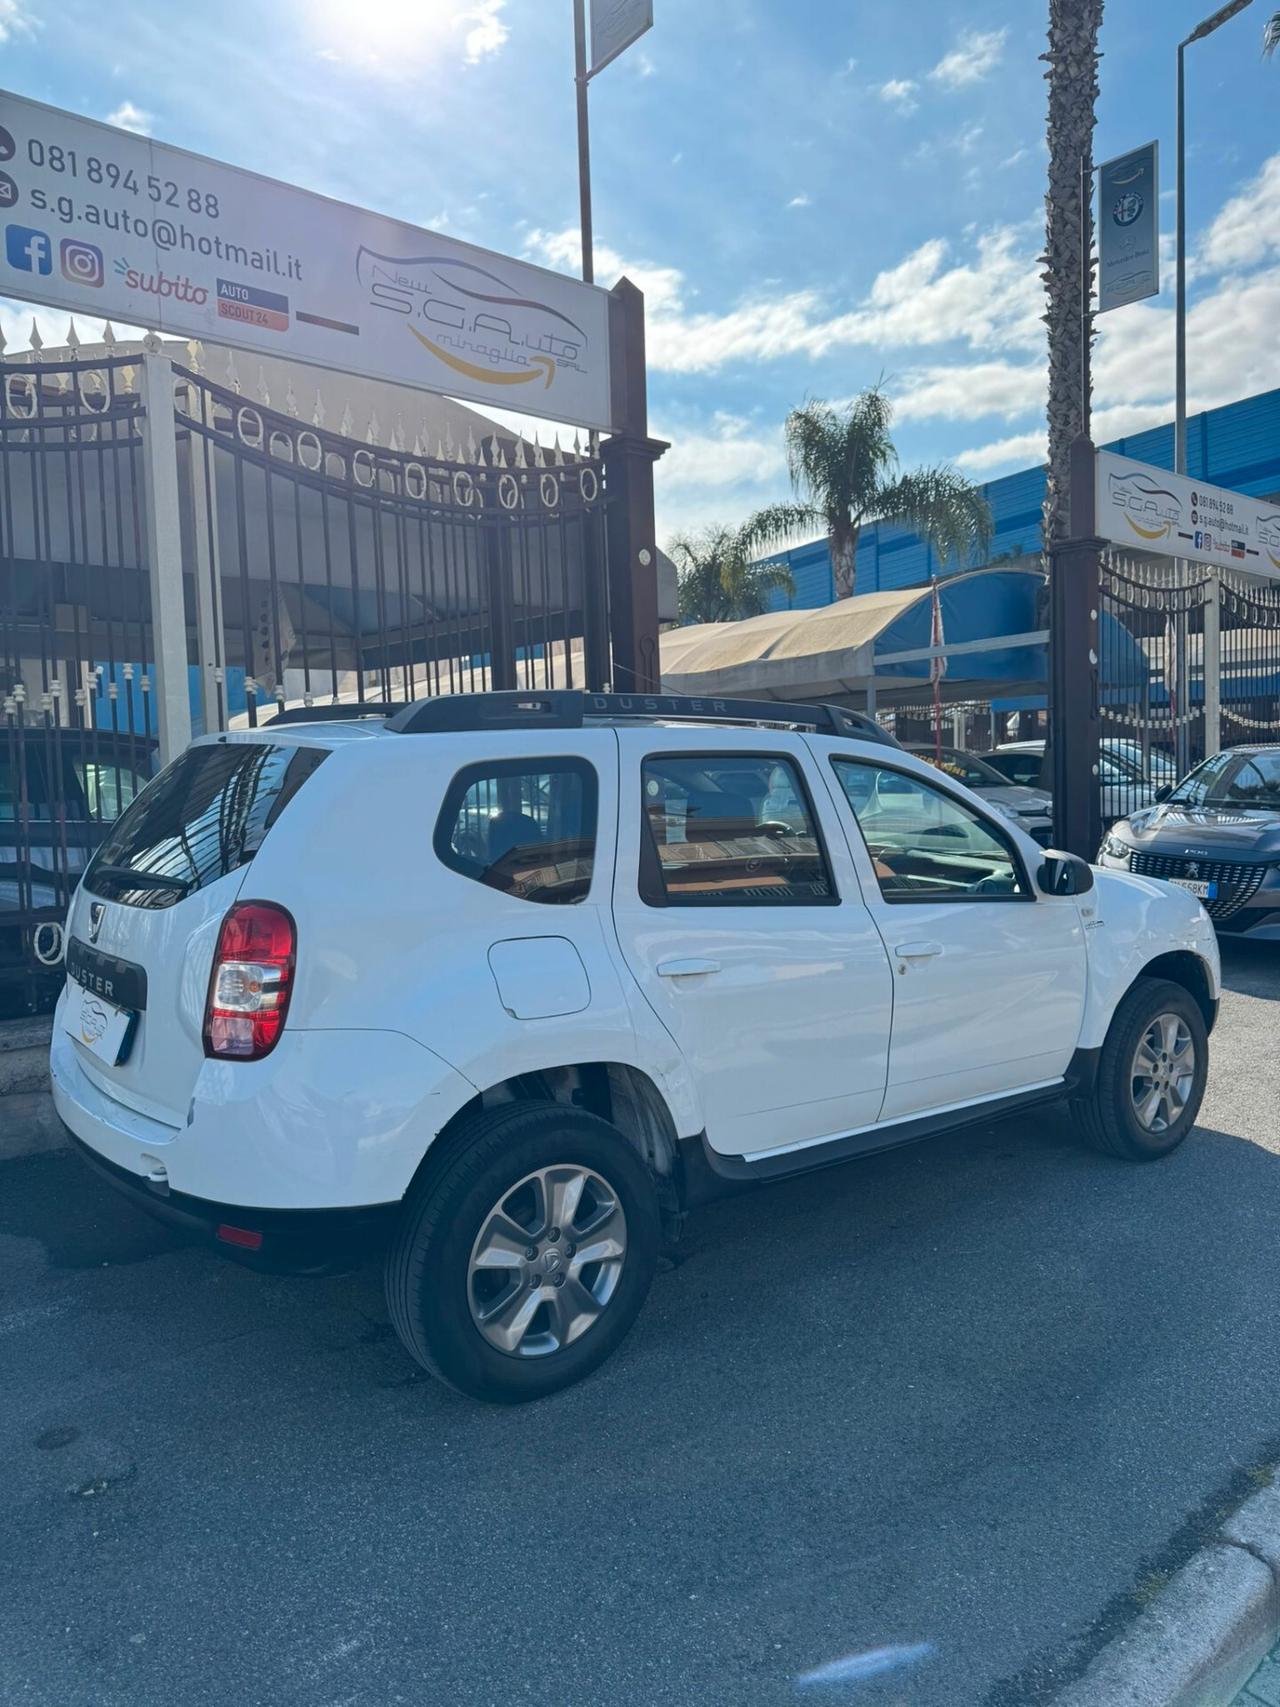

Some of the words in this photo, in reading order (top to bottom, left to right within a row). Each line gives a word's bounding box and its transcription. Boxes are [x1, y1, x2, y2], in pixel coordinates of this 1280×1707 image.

[28, 138, 78, 177] 081
[86, 156, 139, 196] 894
[147, 174, 180, 208] 52
[187, 187, 220, 219] 88
[29, 187, 303, 281] s.g.auto@hotmail.it
[124, 269, 209, 306] subito
[220, 283, 249, 301] AUTO
[371, 264, 432, 295] New
[436, 333, 532, 367] miraglia
[593, 697, 728, 713] DUSTER
